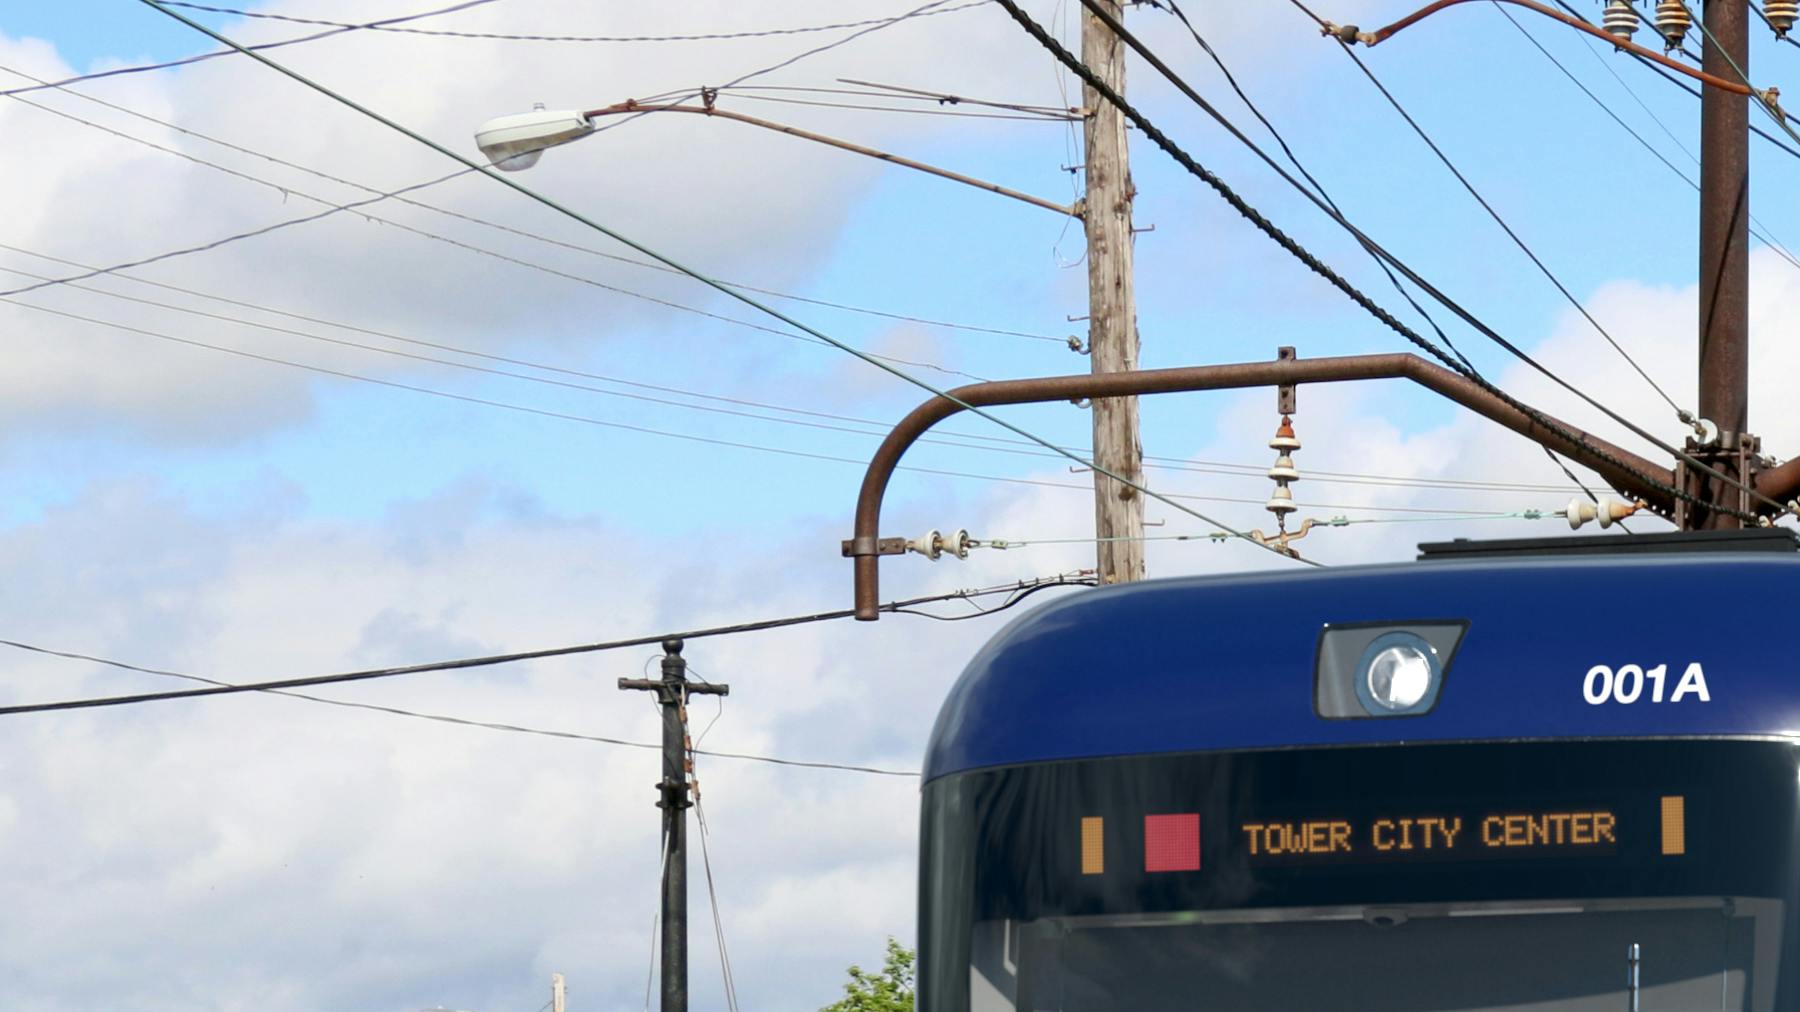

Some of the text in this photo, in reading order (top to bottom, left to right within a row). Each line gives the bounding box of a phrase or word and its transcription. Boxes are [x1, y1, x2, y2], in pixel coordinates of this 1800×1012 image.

[1583, 662, 1711, 705] 001A
[1243, 811, 1616, 855] TOWER CITY CENTER
